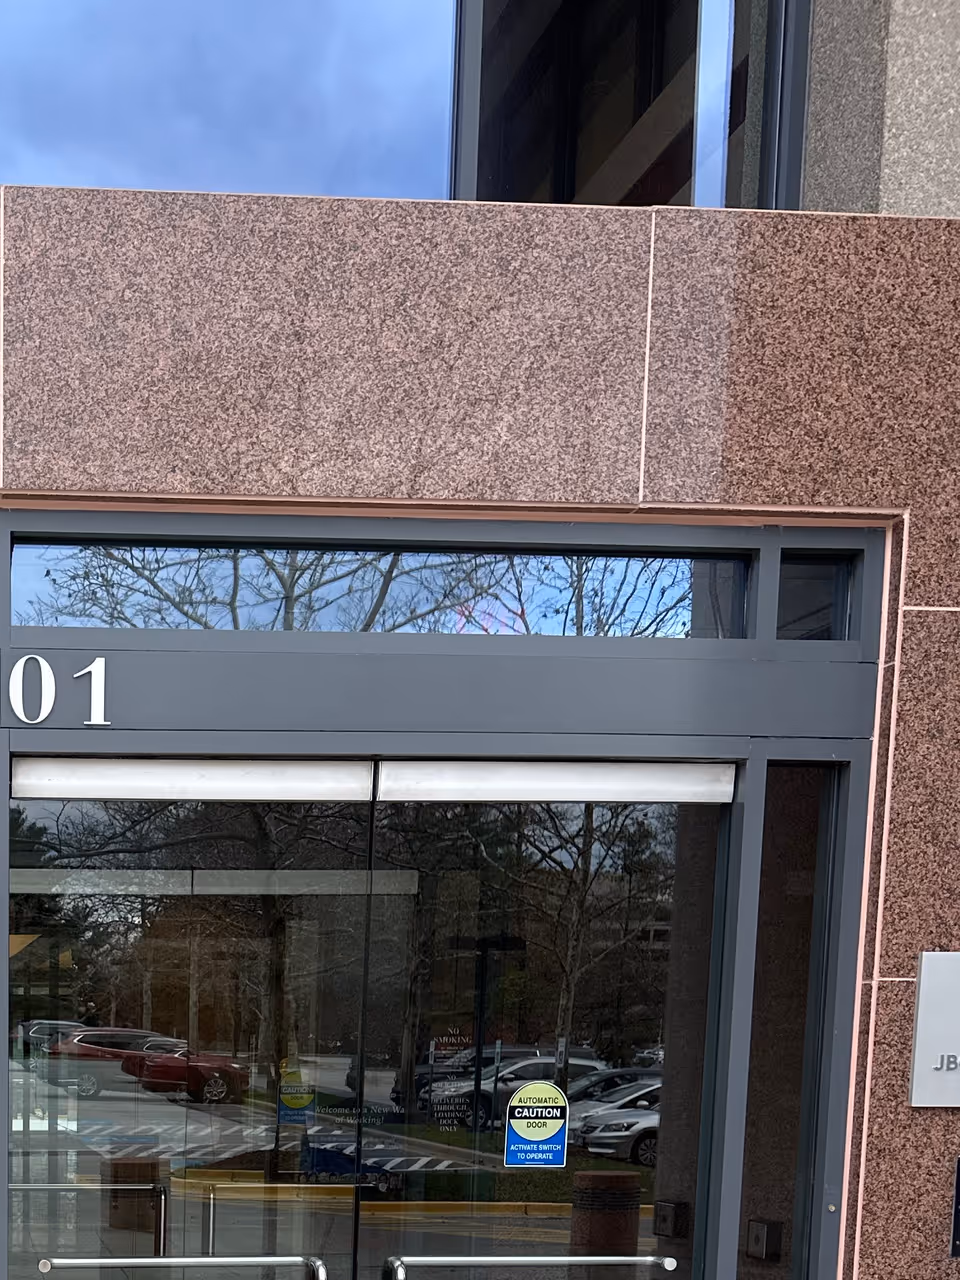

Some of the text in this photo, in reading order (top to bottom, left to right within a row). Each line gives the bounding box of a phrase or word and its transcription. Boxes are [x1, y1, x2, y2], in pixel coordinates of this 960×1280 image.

[434, 1036, 472, 1044] SMOKING
[932, 1054, 960, 1072] JB
[515, 1108, 561, 1117] CAUTION
